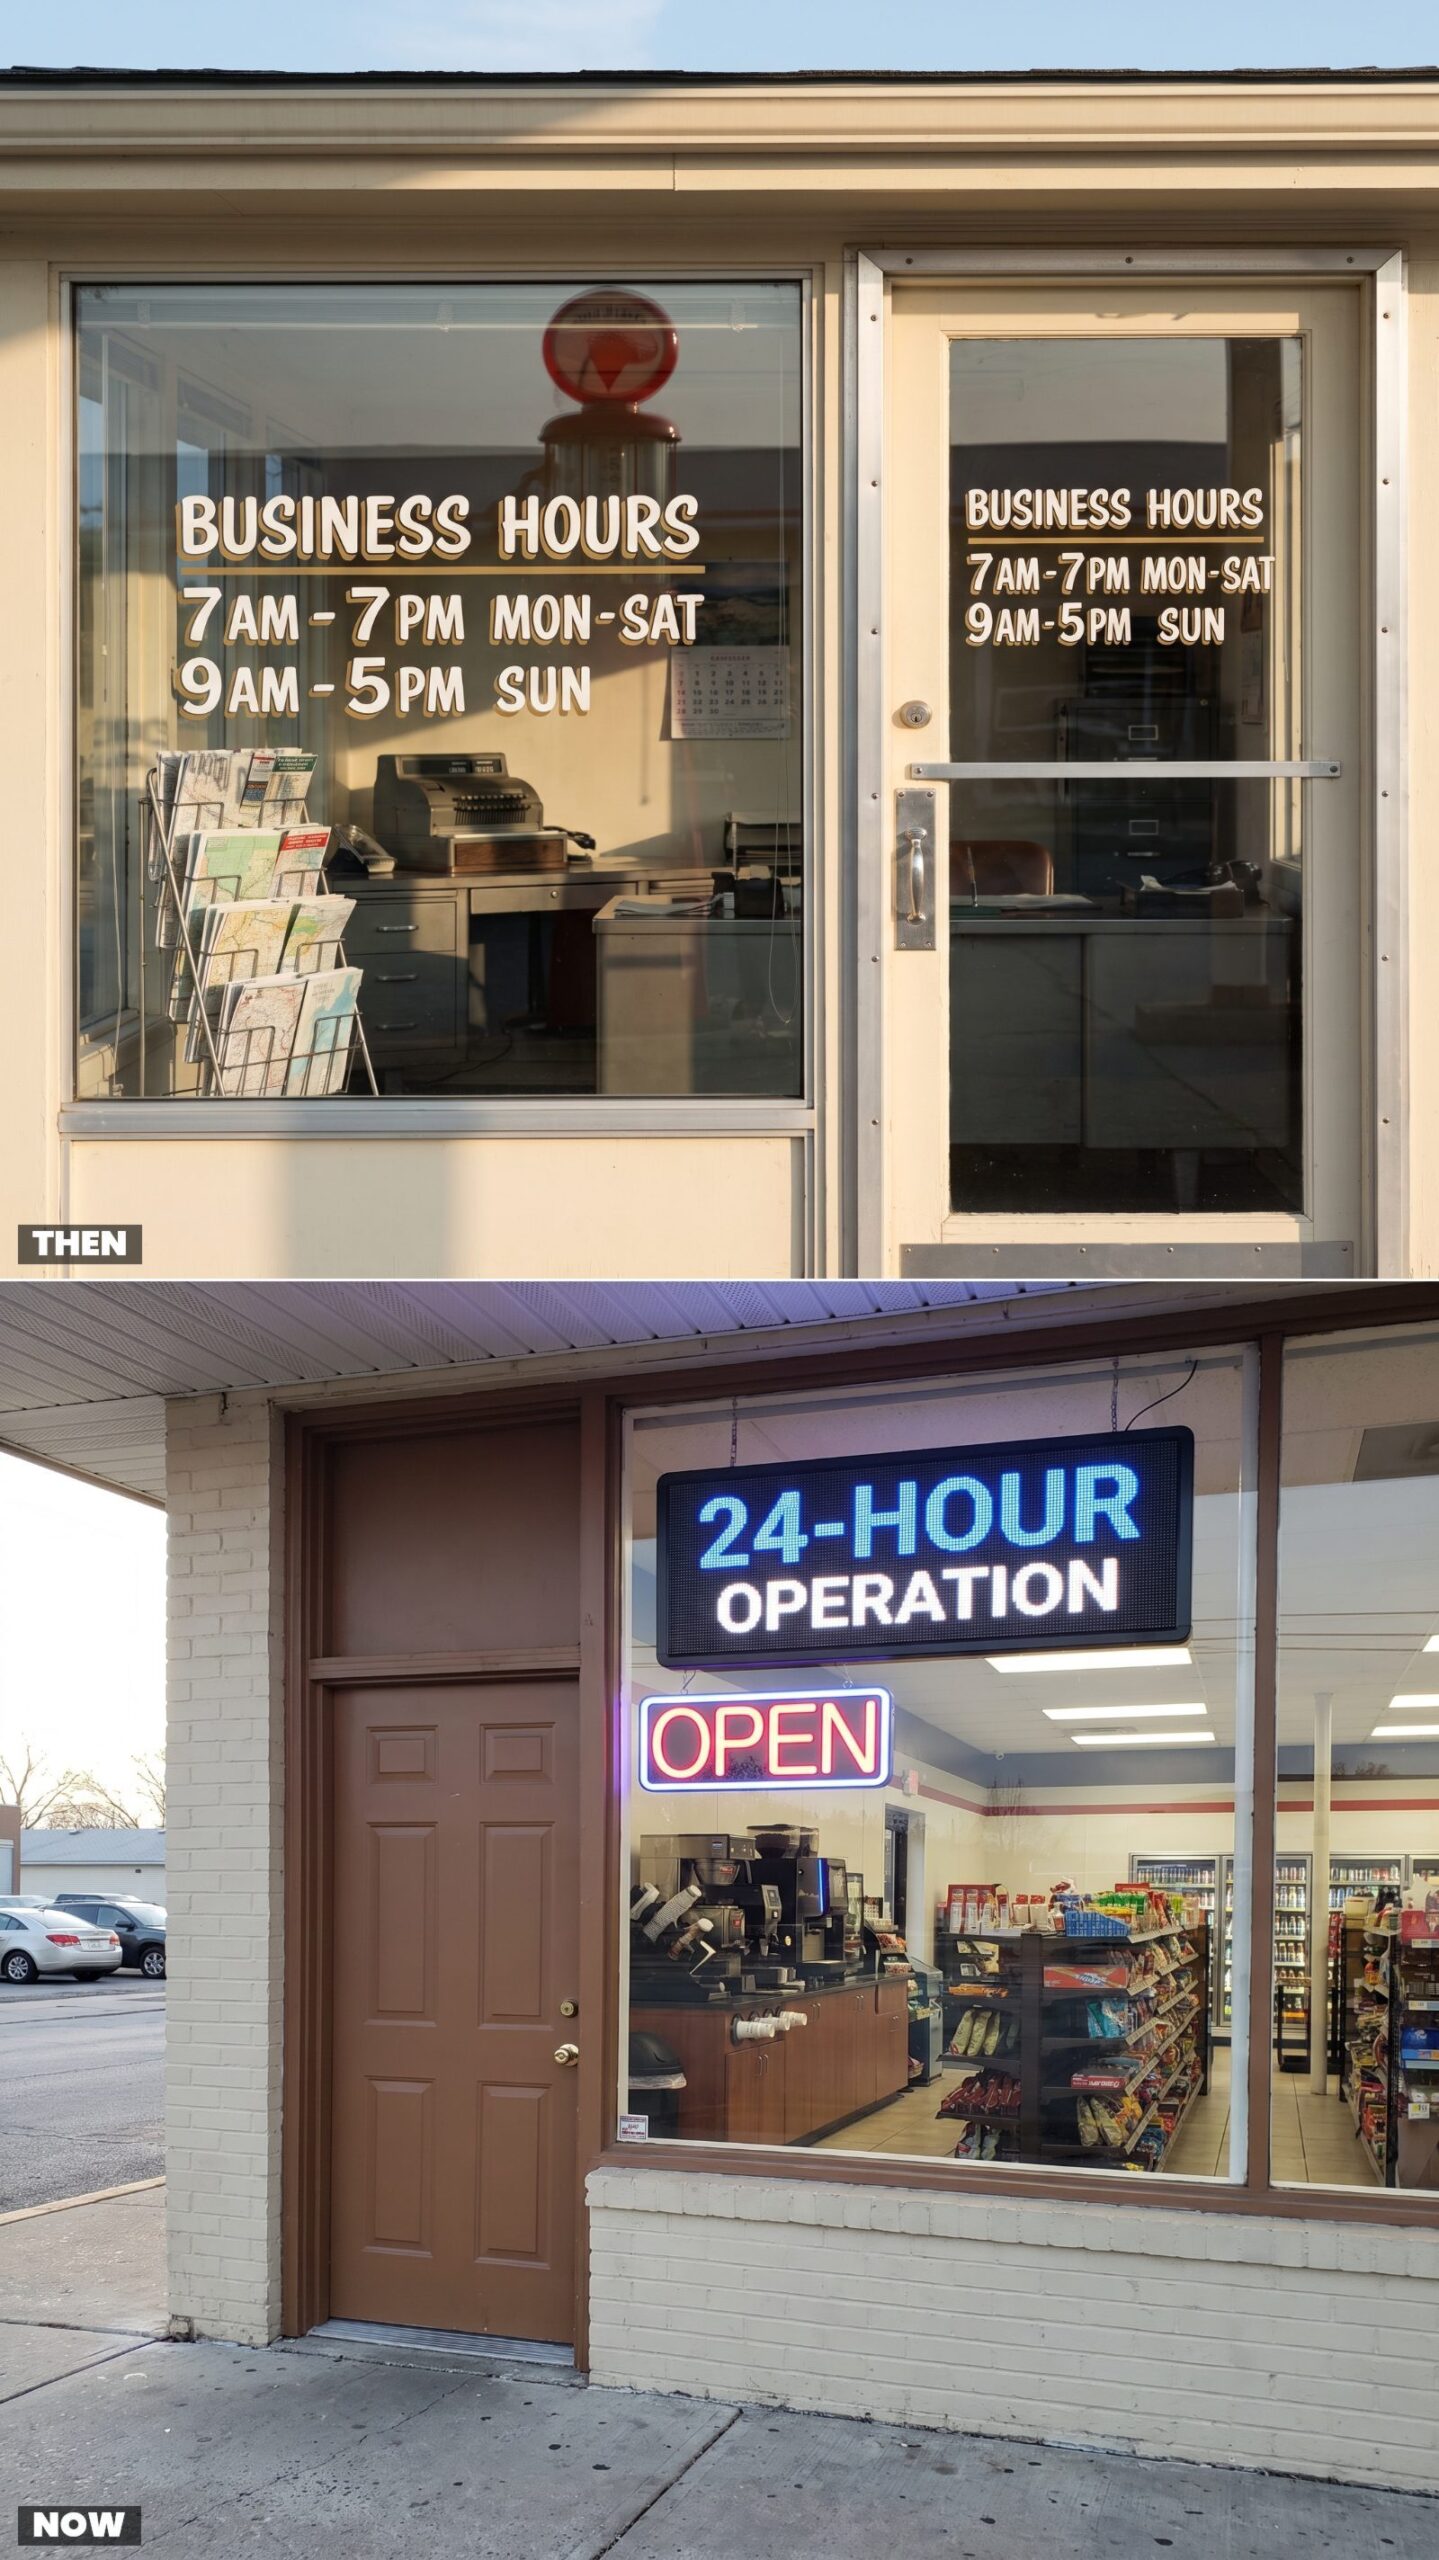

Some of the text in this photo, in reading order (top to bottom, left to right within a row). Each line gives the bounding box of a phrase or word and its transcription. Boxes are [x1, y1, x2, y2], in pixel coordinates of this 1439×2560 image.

[176, 494, 700, 560] BUSINESS HOURS
[965, 488, 1263, 530] BUSINESS HOURS
[1140, 556, 1275, 595] MON-SAT
[490, 594, 704, 646] MON-SAT
[1157, 607, 1225, 646] SUN
[493, 665, 590, 718] SUN
[699, 1464, 1141, 1570] 24-HOUR
[716, 1557, 1118, 1633] OPERATION
[651, 1699, 877, 1779] OPEN
